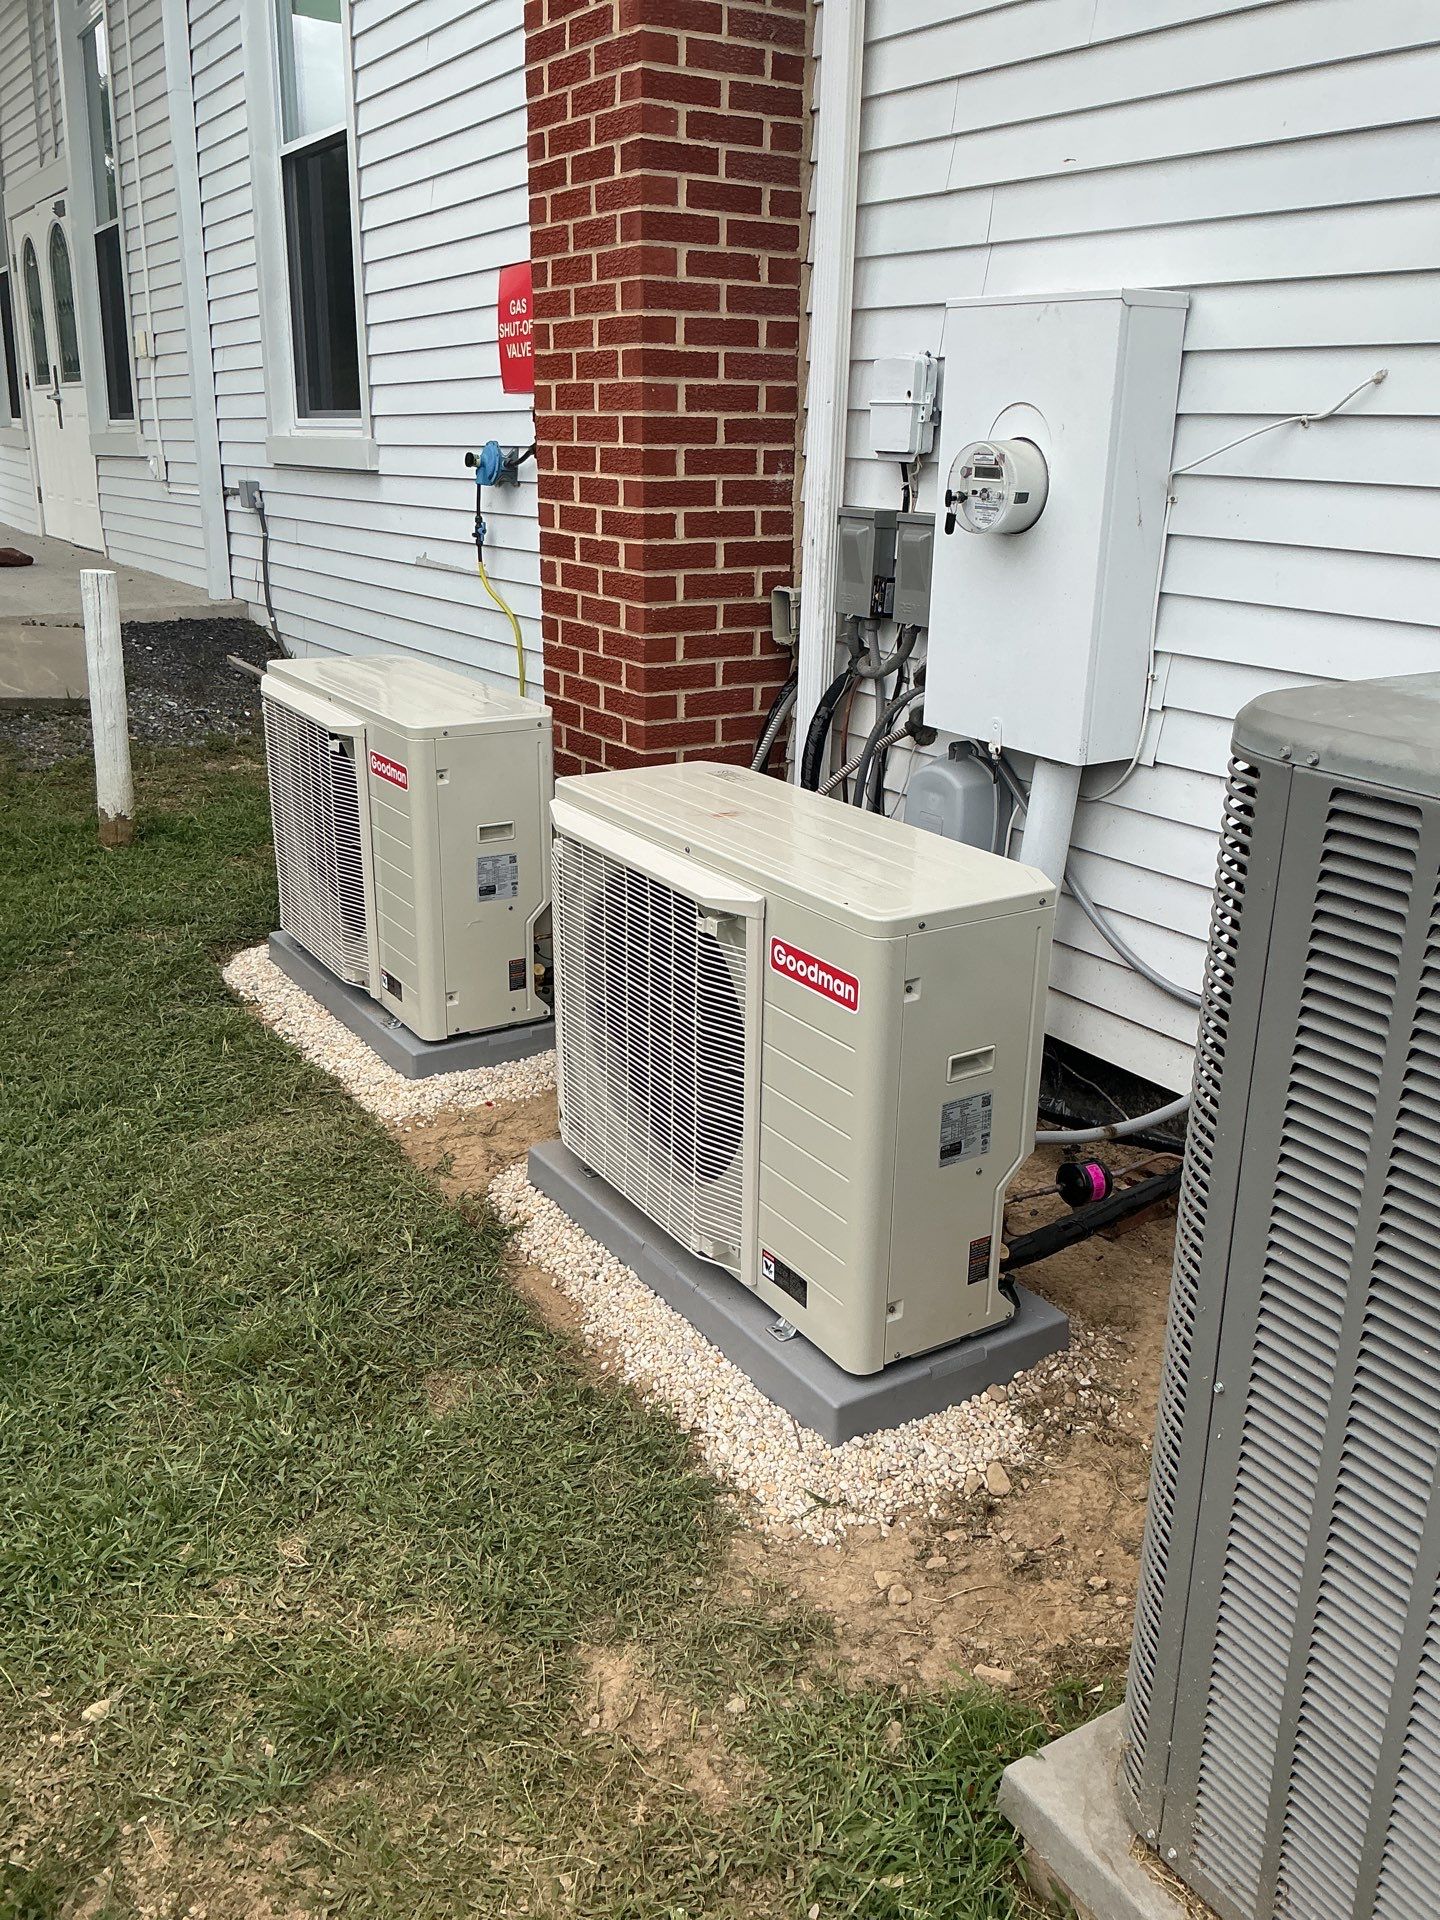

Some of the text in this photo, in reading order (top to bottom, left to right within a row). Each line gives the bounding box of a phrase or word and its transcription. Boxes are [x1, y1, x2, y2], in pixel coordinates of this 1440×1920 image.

[509, 298, 527, 315] GAS
[499, 319, 534, 338] SHUT-OF
[506, 341, 532, 359] VALVE
[371, 755, 407, 785] Goodman
[773, 944, 855, 1003] Goodman
